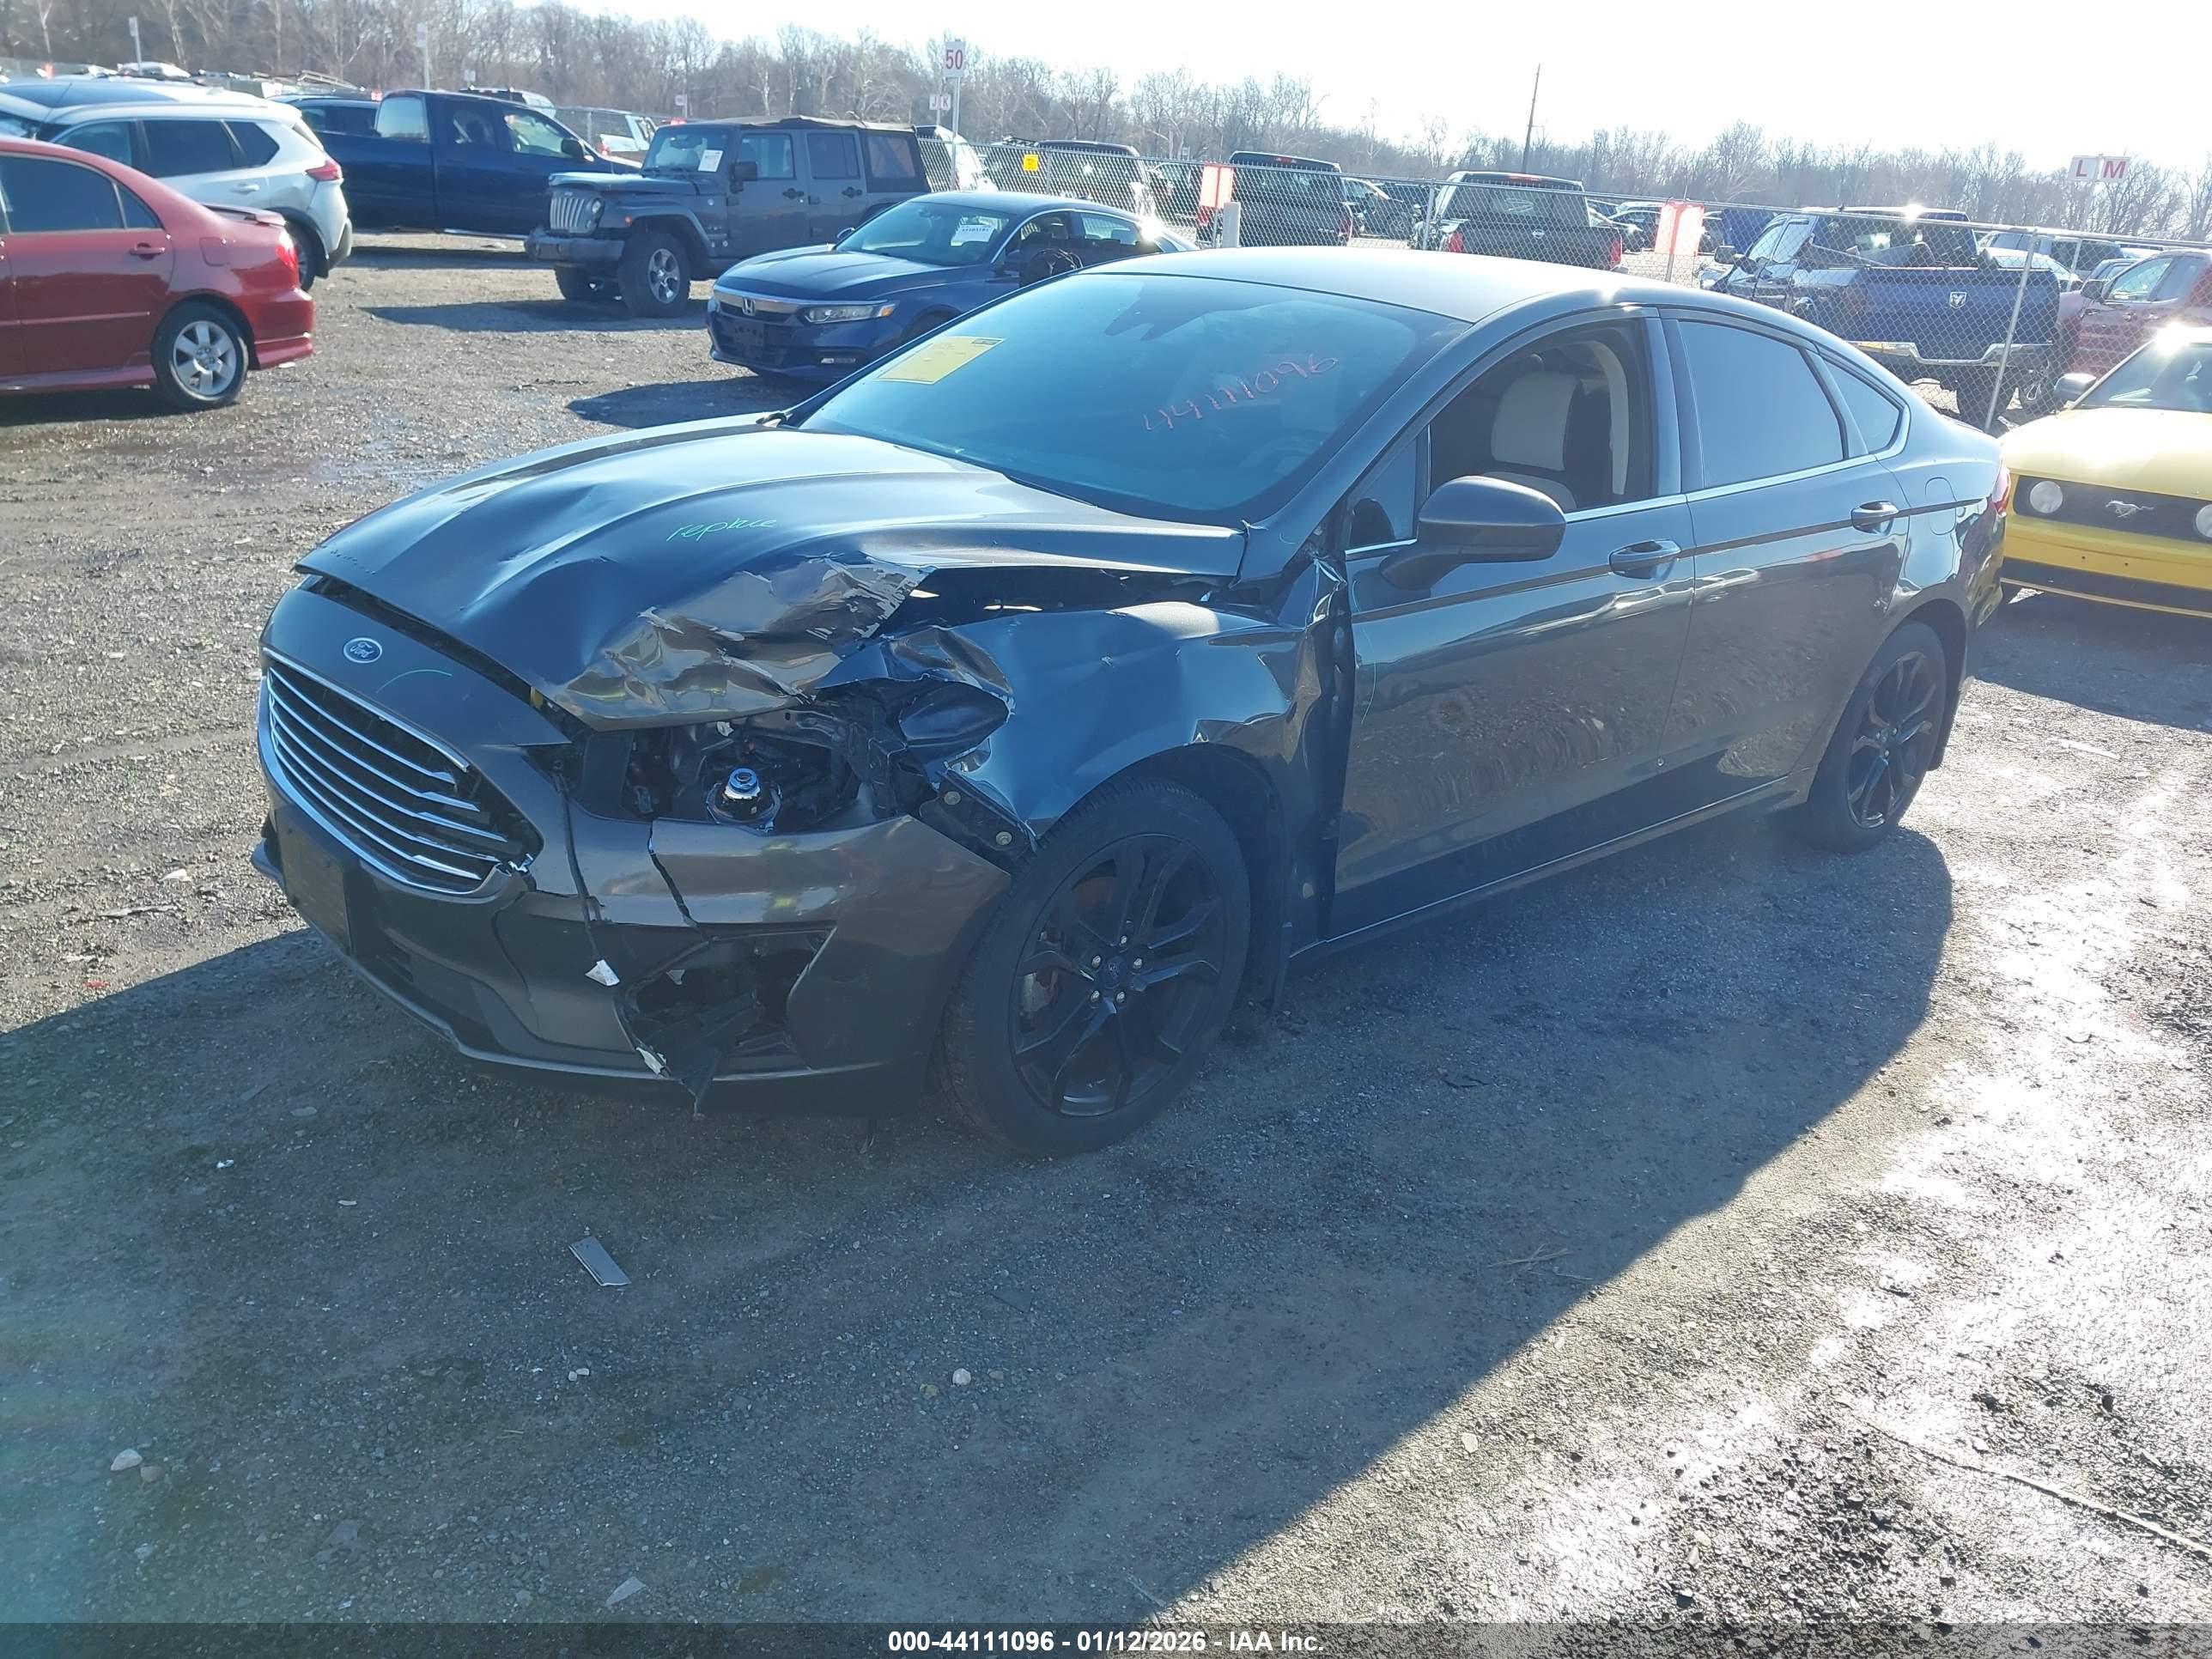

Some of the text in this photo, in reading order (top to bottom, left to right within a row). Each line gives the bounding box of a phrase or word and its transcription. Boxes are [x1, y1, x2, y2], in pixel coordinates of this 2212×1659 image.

[945, 49, 963, 70] 50
[2075, 159, 2126, 179] L M
[349, 641, 375, 659] Ford
